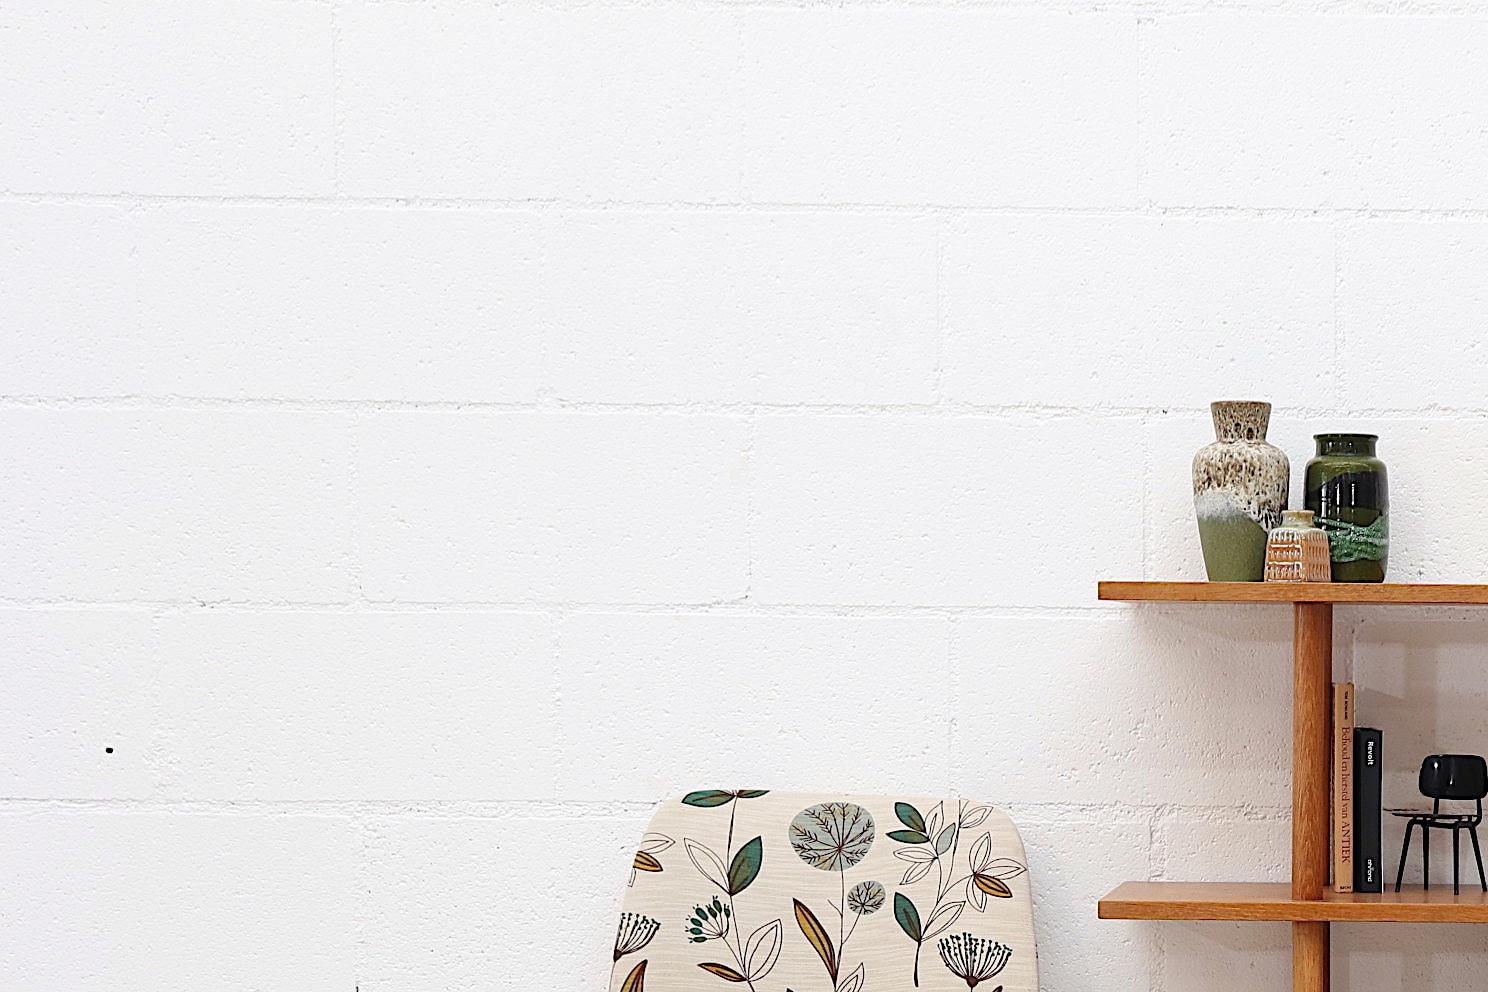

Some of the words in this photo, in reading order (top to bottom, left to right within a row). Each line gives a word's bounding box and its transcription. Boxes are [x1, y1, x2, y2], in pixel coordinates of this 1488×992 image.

[1341, 726, 1351, 760] Behoud
[1367, 741, 1375, 765] Revolt
[1341, 761, 1349, 772] en
[1341, 774, 1351, 801] herstel
[1341, 803, 1349, 819] van
[1341, 821, 1351, 864] ANTIEK
